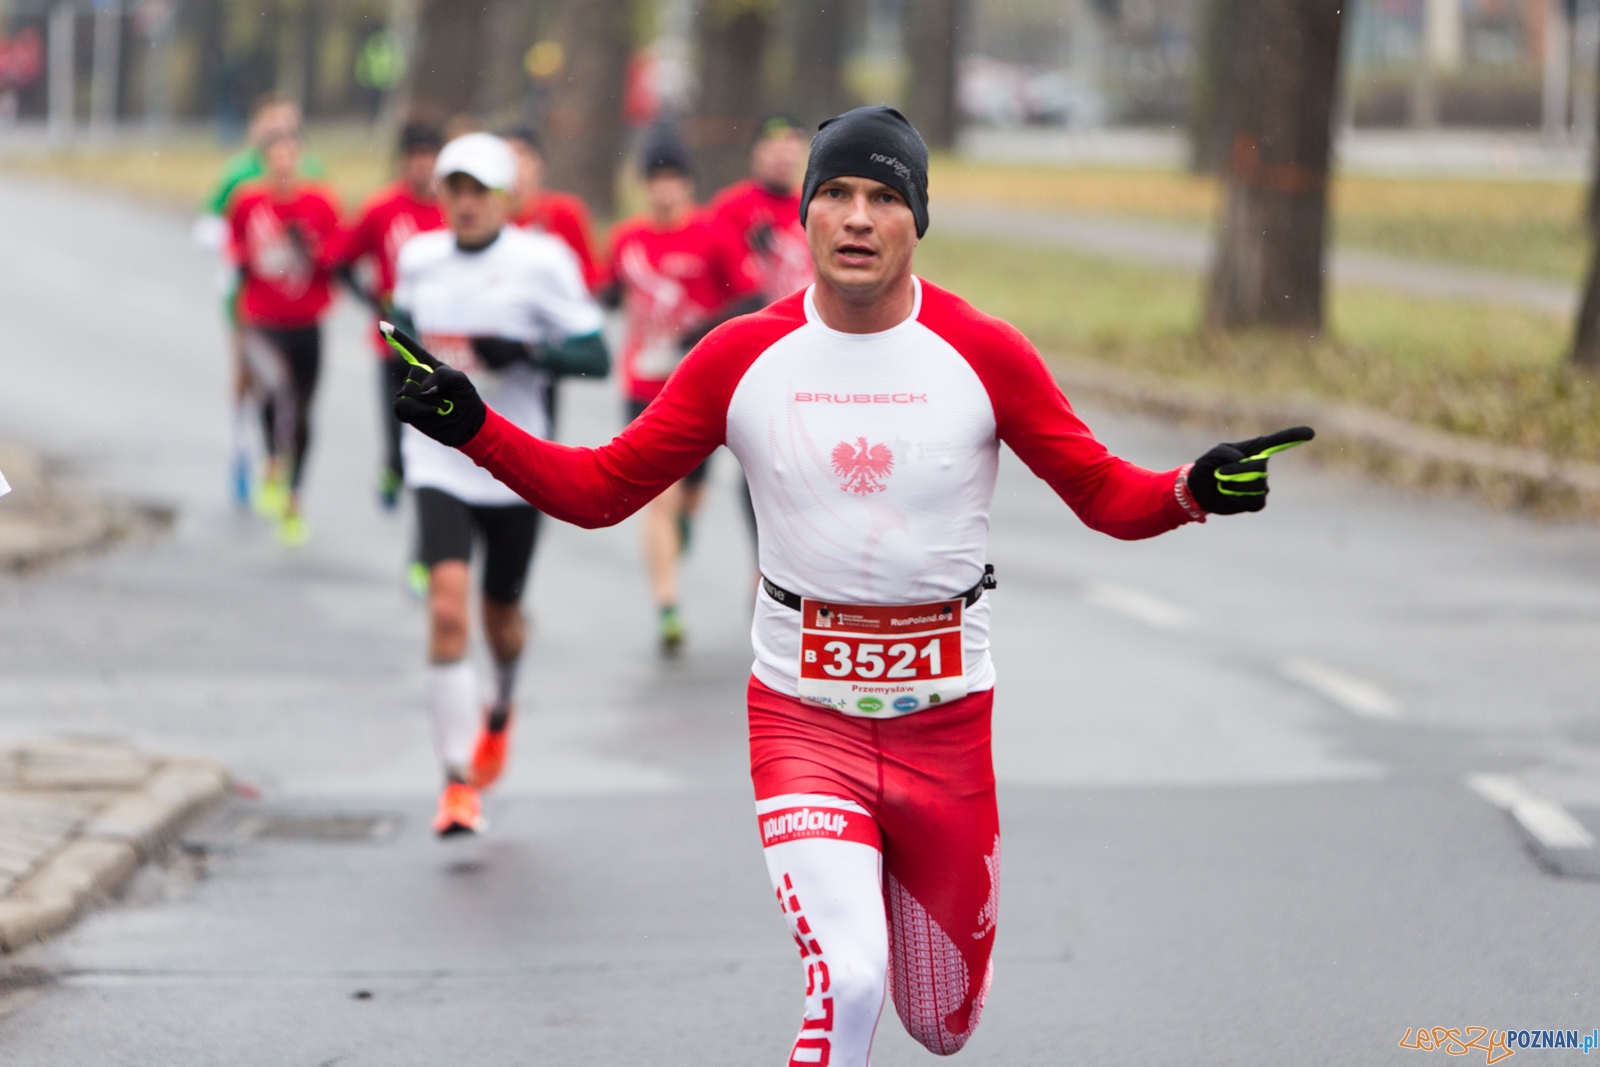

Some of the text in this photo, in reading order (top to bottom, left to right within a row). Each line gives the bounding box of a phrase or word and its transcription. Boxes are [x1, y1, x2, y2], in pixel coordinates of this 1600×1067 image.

[794, 391, 928, 404] BRUBECK
[890, 613, 953, 626] RunPoland.org
[804, 637, 942, 679] B 3521
